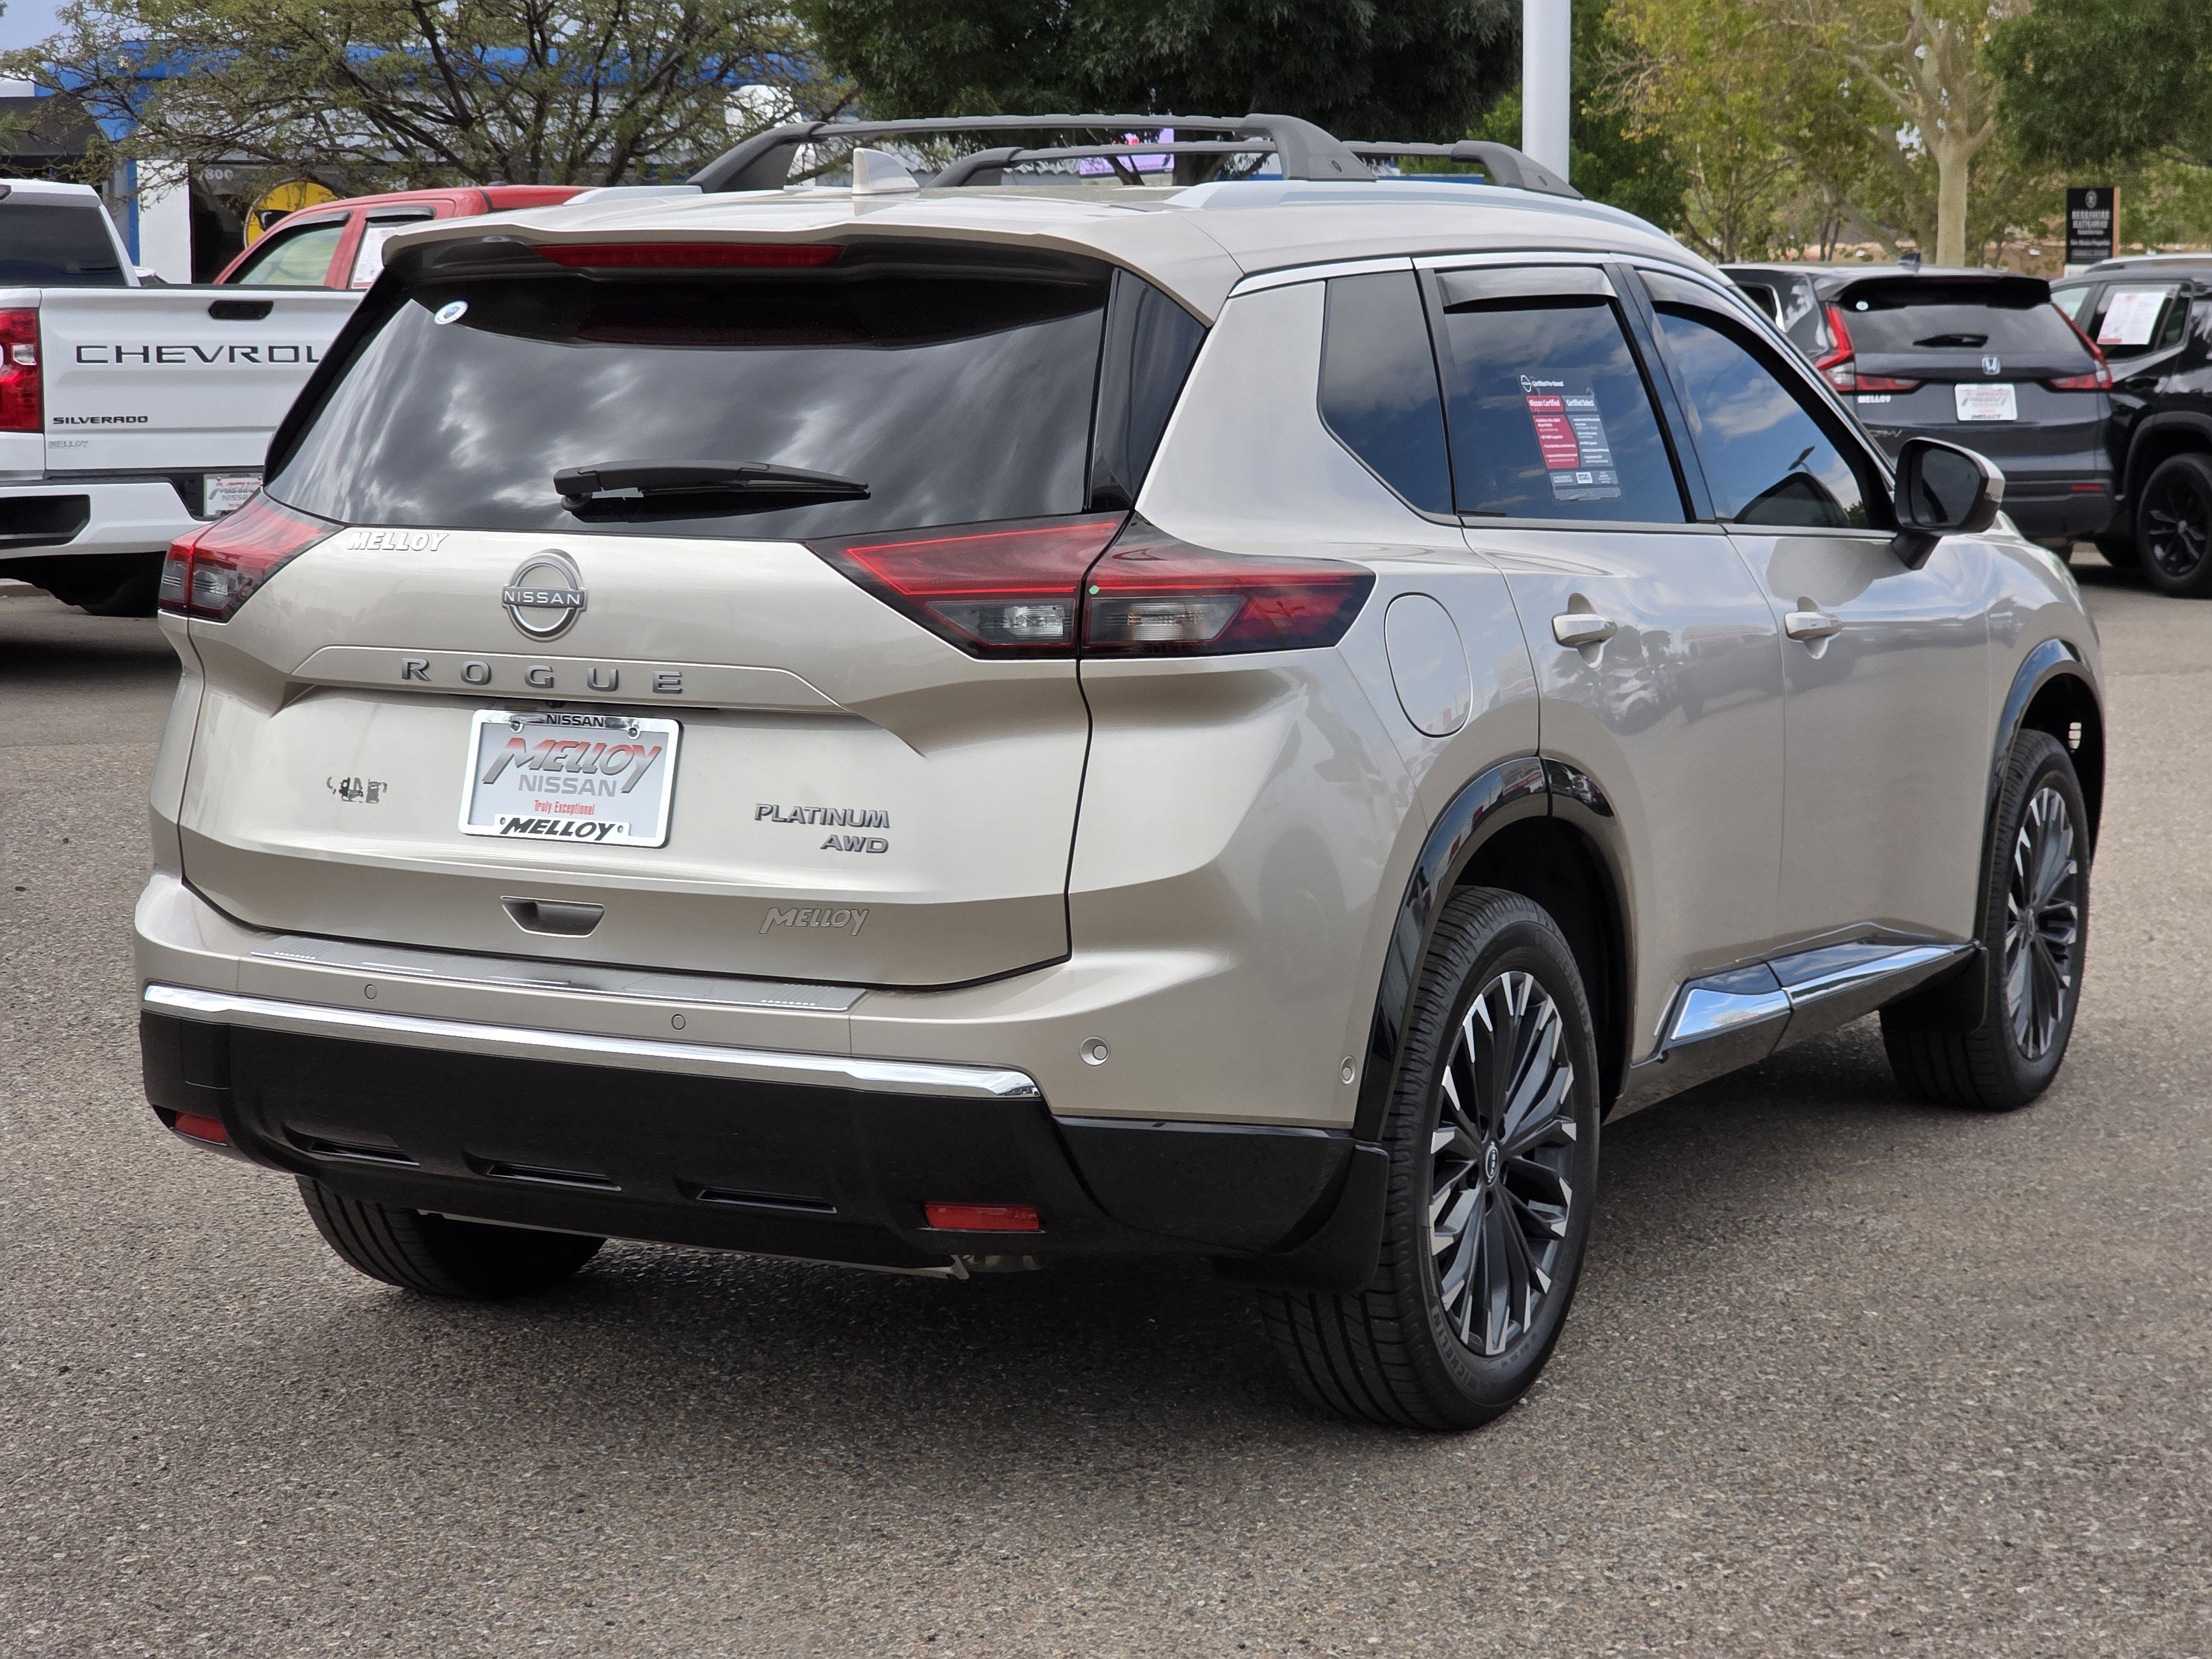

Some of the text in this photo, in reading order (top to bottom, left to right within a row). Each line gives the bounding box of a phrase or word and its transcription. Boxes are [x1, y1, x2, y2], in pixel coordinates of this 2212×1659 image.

[76, 345, 320, 363] CHEVROL
[53, 416, 148, 424] SILVERADO
[48, 441, 88, 449] MELLOY
[347, 531, 449, 551] MELLOY
[504, 590, 581, 606] NISSAN
[401, 658, 682, 694] ROGUE
[546, 714, 604, 727] NISSAN
[482, 737, 661, 794] MELLOY
[519, 774, 617, 797] NISSAN
[534, 800, 595, 816] Truly Exceptional
[754, 803, 890, 828] PLATINUM
[500, 817, 615, 841] MELLOY
[820, 834, 889, 853] AWD
[759, 907, 869, 936] MELLOY
